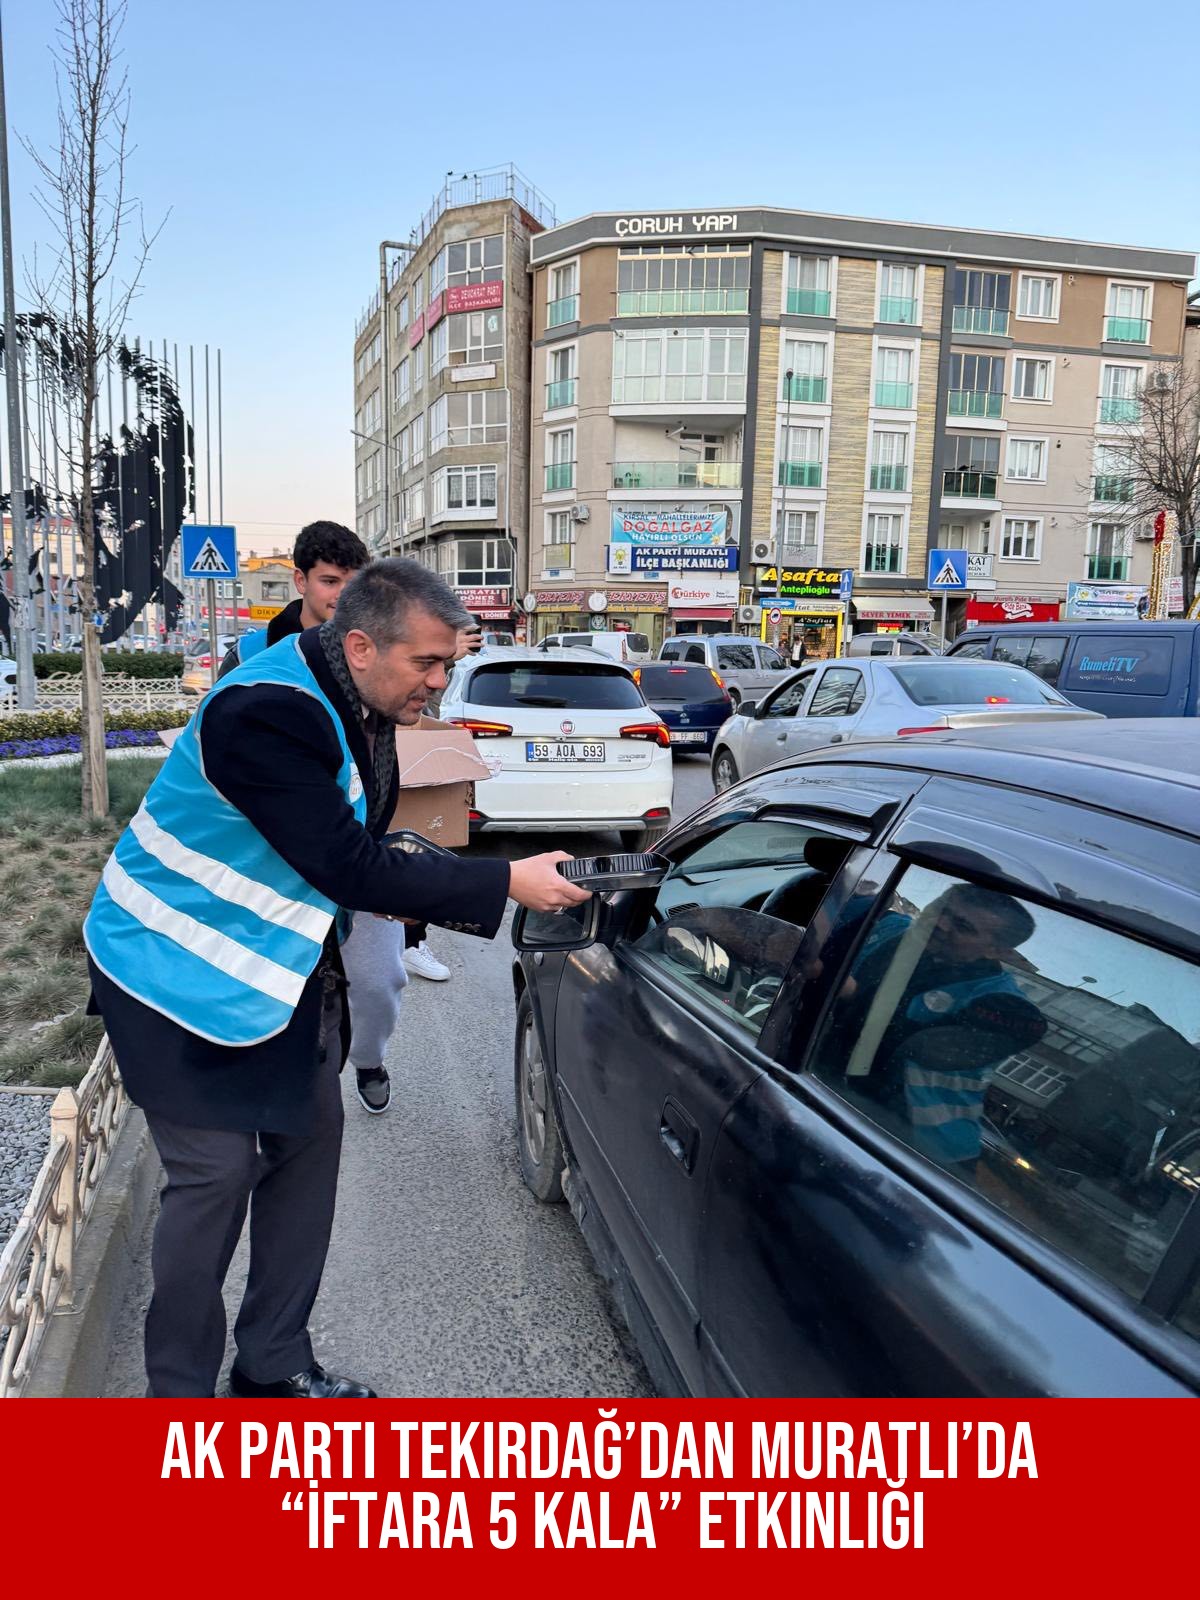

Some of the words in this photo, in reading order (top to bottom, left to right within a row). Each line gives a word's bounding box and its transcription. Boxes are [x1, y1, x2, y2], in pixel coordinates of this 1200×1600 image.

[615, 216, 683, 237] ÇORUH
[692, 214, 738, 232] YAPI
[623, 518, 713, 533] DOĞALGAZ
[632, 533, 669, 541] HAYIRLI
[671, 533, 703, 541] OLSUN
[635, 548, 651, 556] AK
[652, 546, 681, 556] PARTİ
[683, 548, 728, 556] MURATLI
[636, 556, 659, 570] İLÇE
[661, 557, 729, 570] BAŞKANLIĞI
[780, 585, 831, 595] Anteplioğlu
[535, 744, 549, 757] 59
[583, 745, 603, 758] 693
